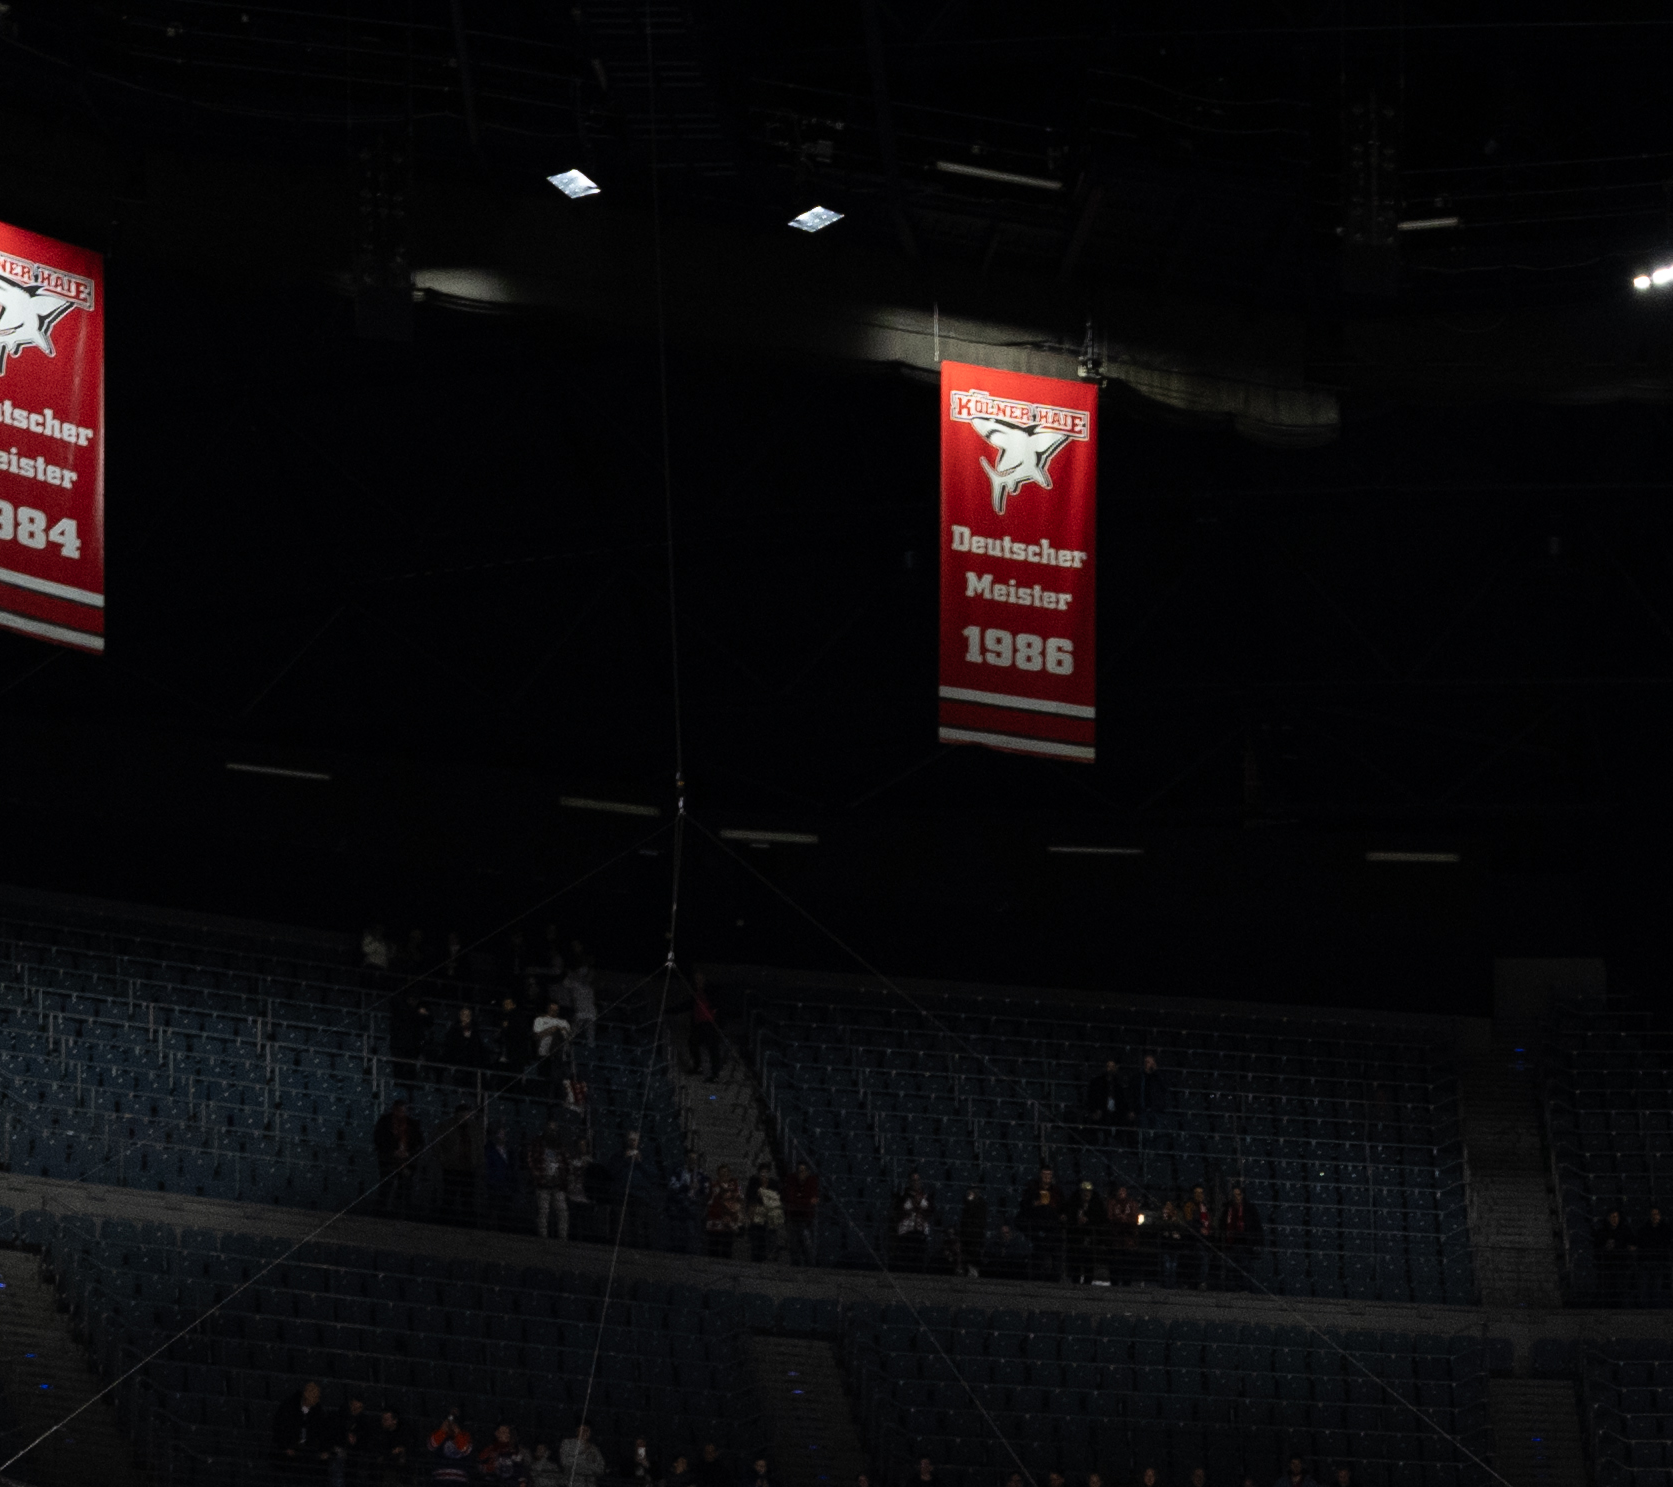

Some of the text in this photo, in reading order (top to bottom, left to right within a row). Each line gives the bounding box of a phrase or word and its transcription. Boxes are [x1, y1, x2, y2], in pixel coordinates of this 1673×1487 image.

[39, 272, 89, 303] HAIE
[957, 394, 1083, 436] KÖLNER HAIE
[951, 525, 1087, 568] Deutscher
[965, 571, 1072, 610] Meister
[962, 626, 1074, 675] 1986
